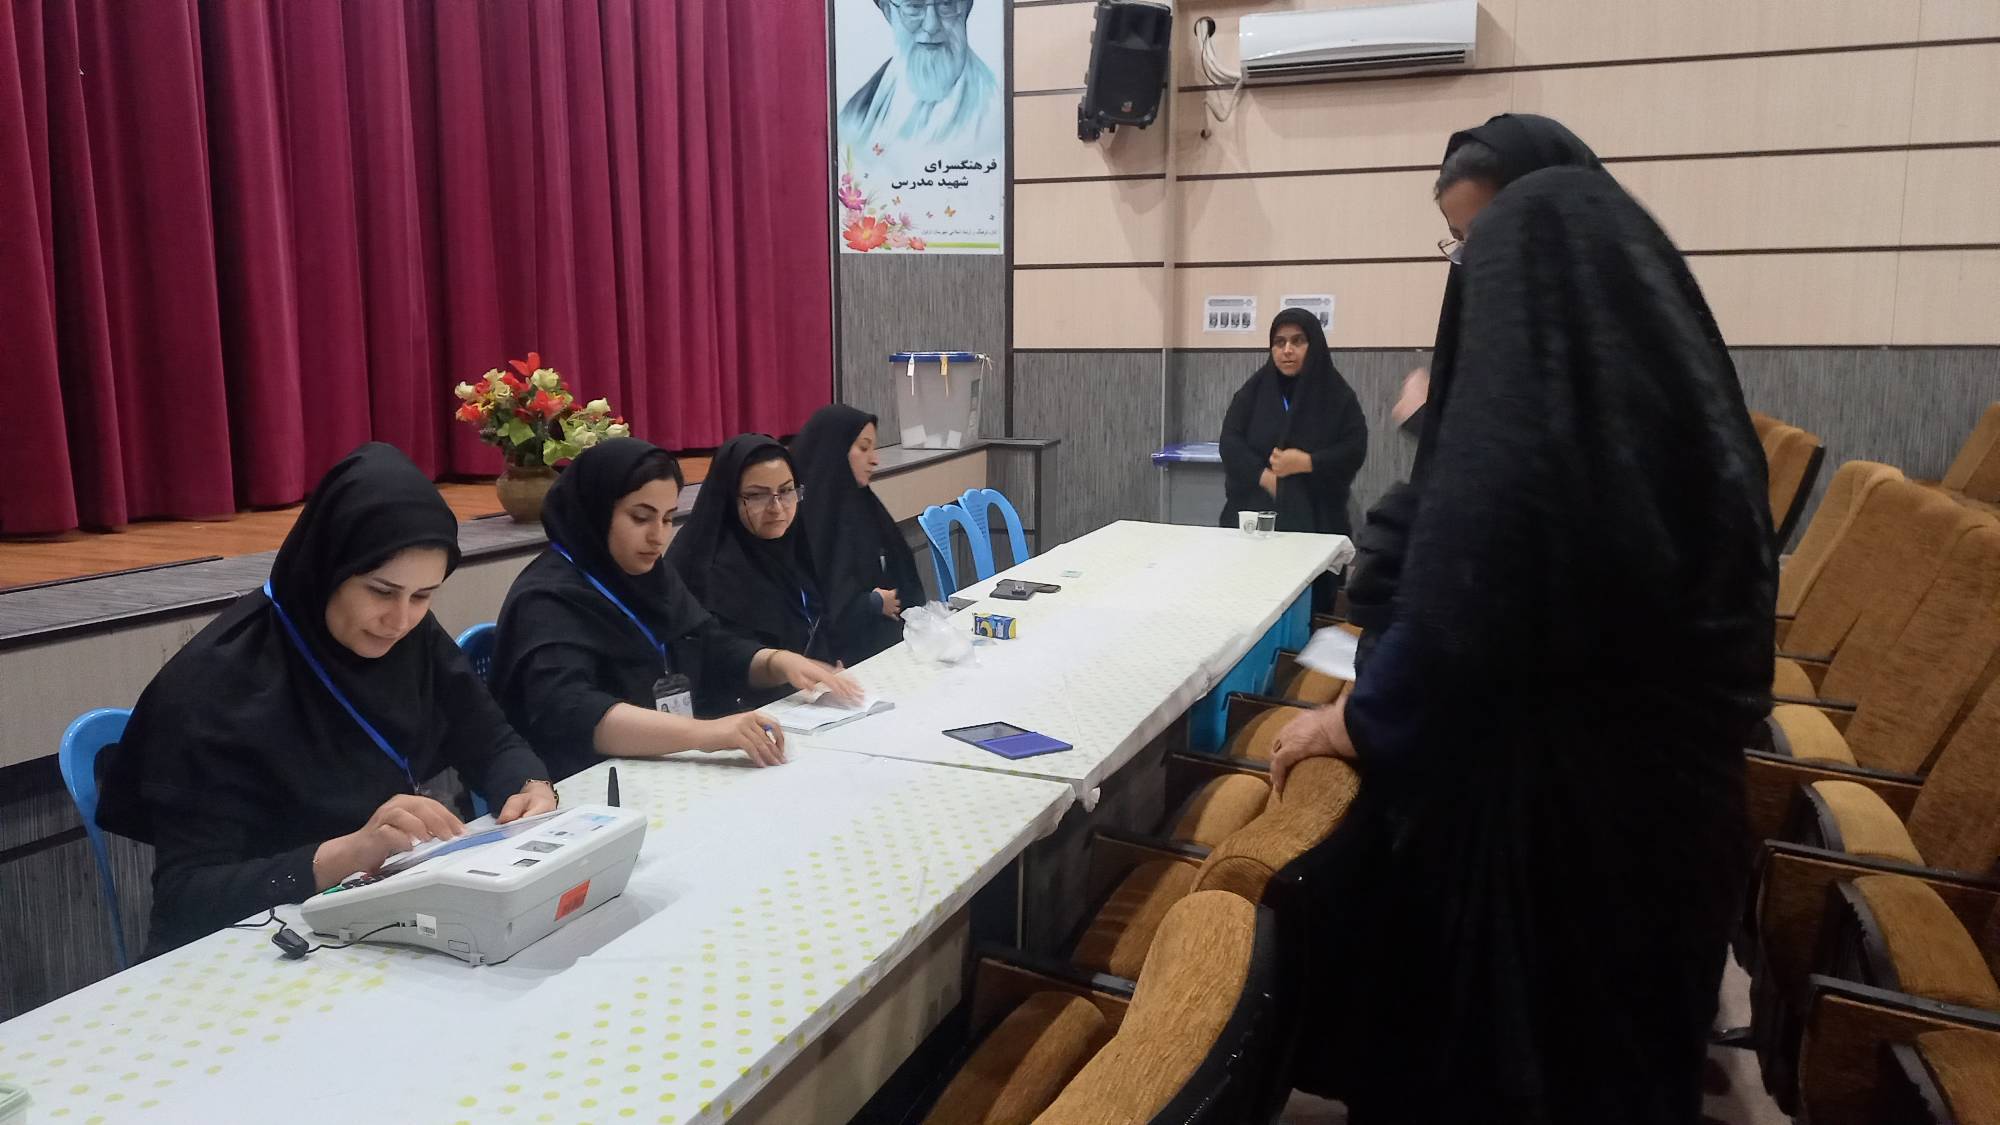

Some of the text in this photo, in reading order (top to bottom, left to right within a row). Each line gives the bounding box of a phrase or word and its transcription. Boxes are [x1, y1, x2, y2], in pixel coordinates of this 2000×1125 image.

[924, 158, 997, 173] فرهنگسرای
[891, 176, 969, 189] شهید مدرس
